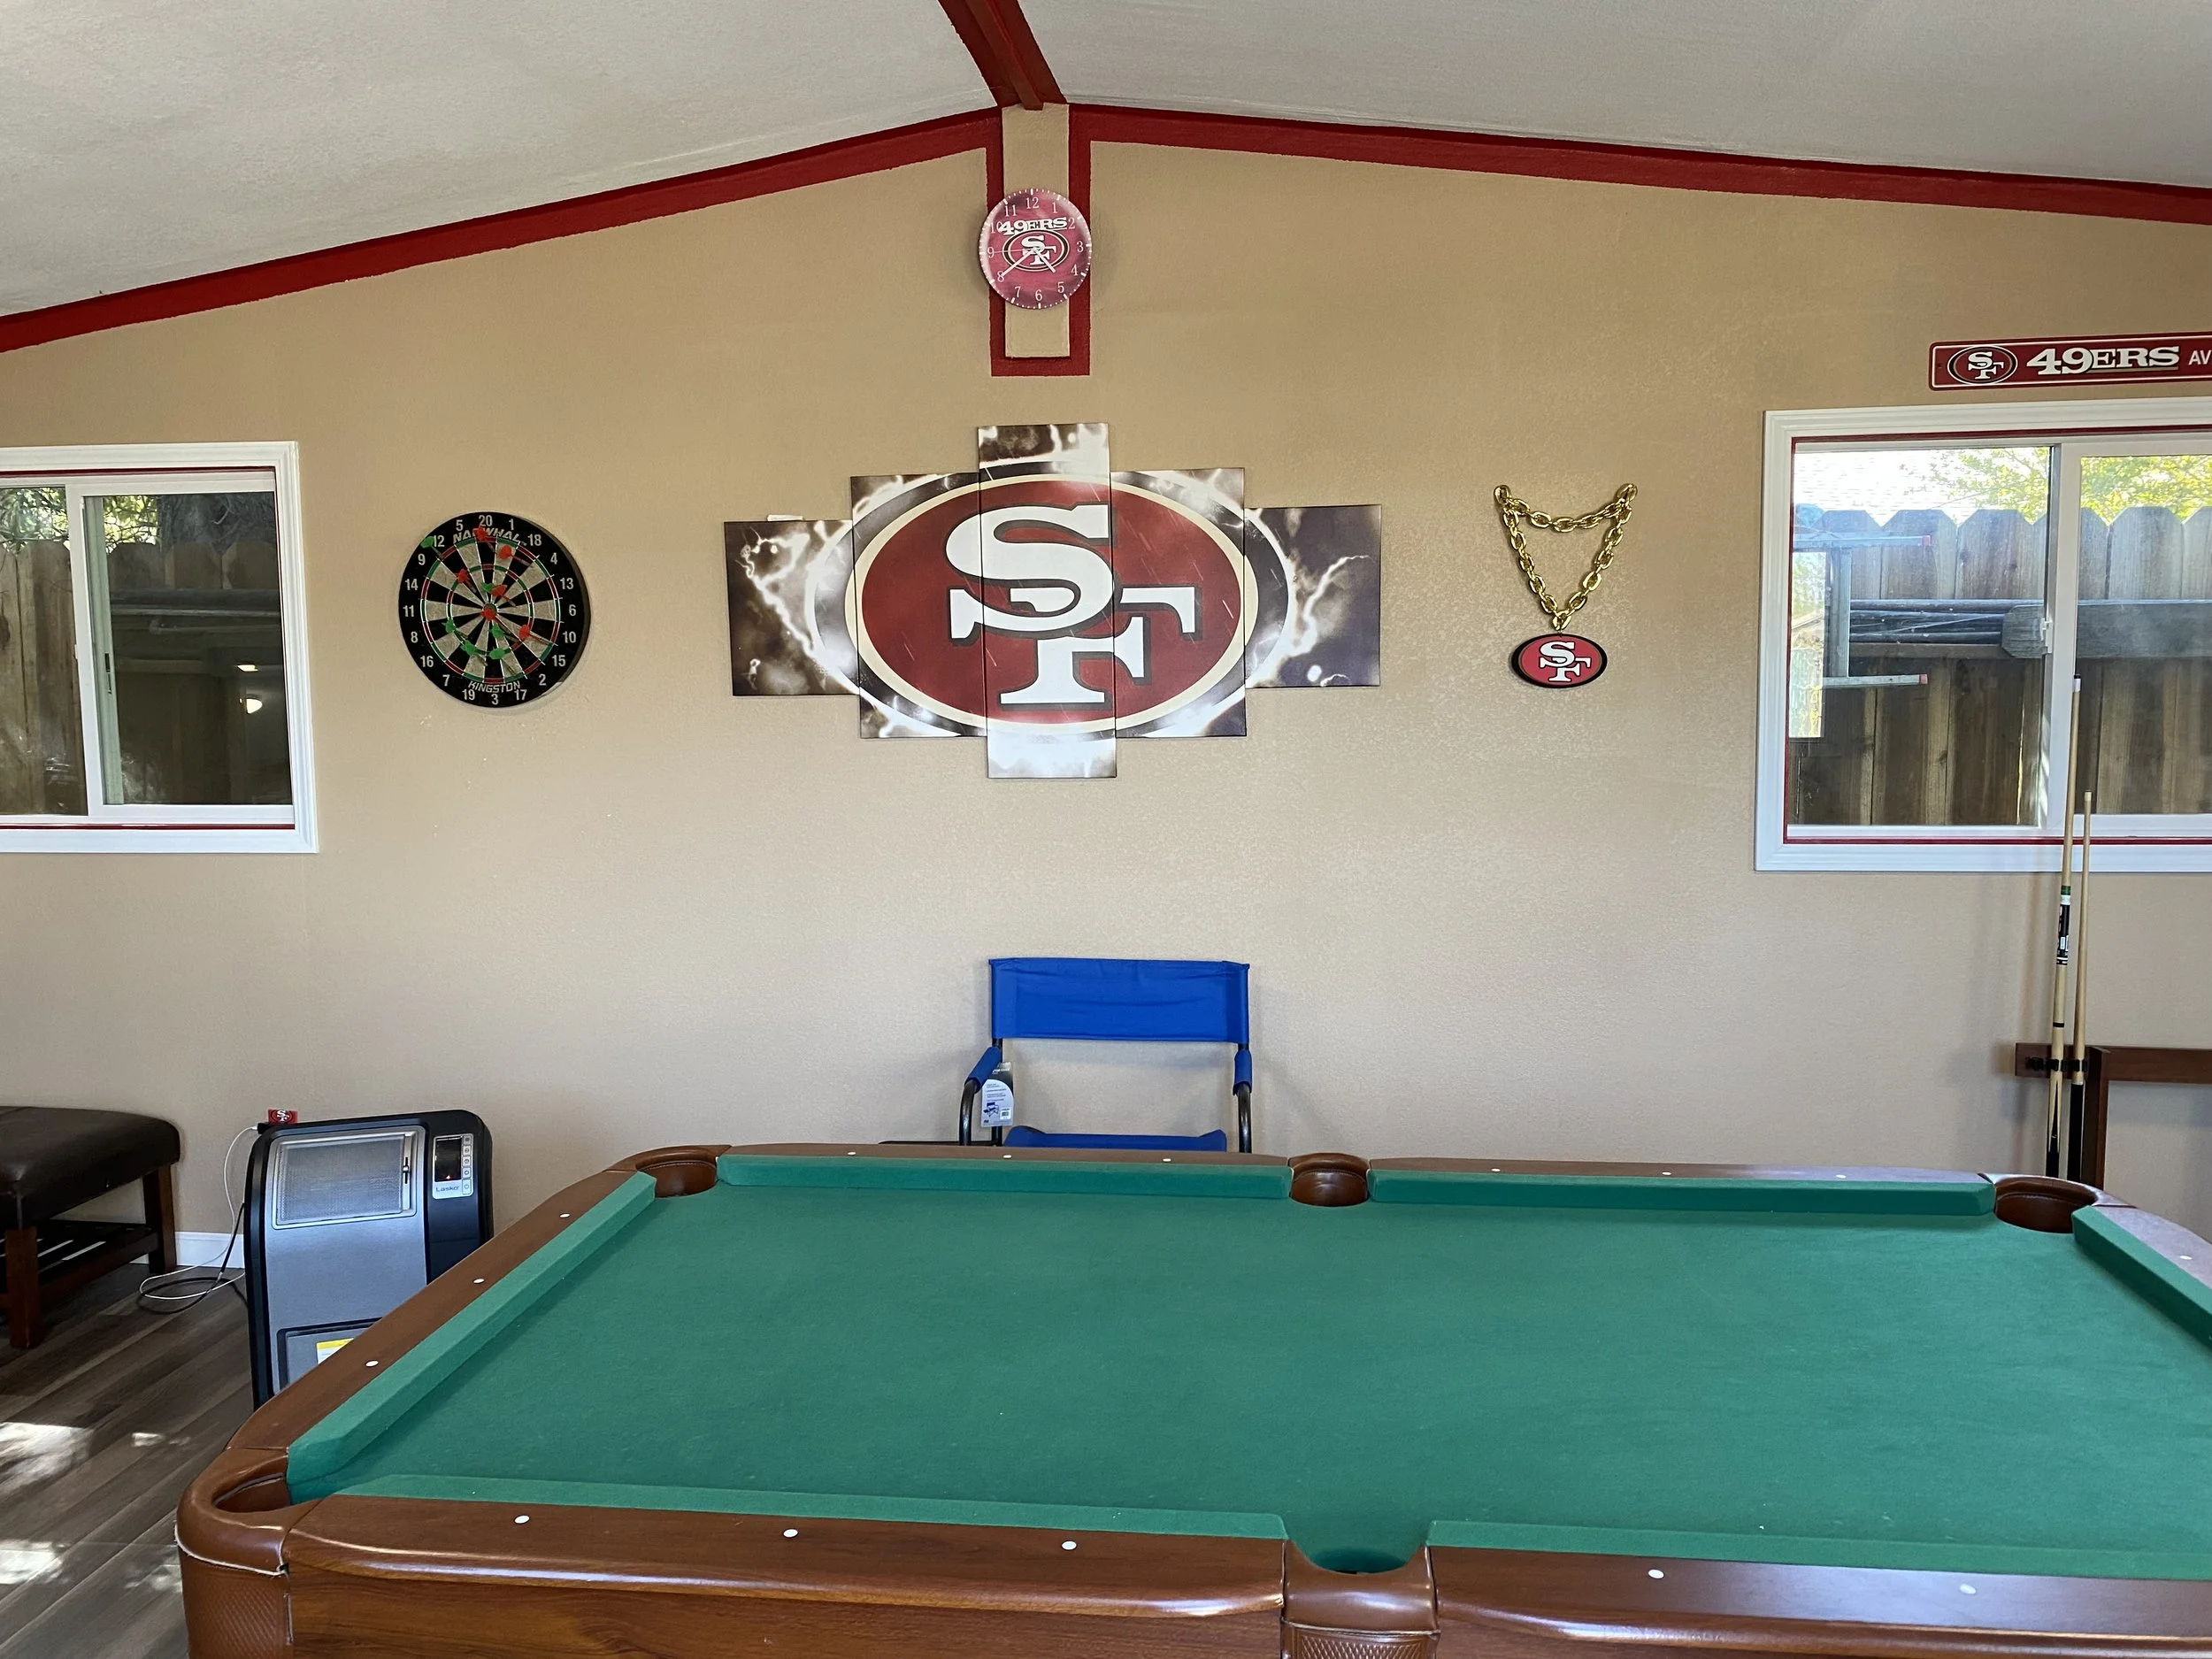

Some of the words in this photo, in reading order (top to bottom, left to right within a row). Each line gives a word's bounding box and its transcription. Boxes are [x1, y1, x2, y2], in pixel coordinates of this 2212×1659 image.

[1026, 197, 1040, 209] 12
[1052, 202, 1057, 213] 1
[1004, 205, 1017, 217] 11
[997, 217, 1068, 235] 49ERS
[1068, 218, 1076, 230] 2
[987, 247, 995, 258] 9
[1021, 235, 1056, 265] SF
[1077, 241, 1084, 253] 3
[1071, 264, 1079, 276] 4
[997, 271, 1004, 282] 8
[1015, 286, 1021, 298] 7
[1057, 281, 1064, 294] 5
[1035, 289, 1042, 301] 6
[1968, 351, 2004, 380] SF
[2026, 346, 2180, 375] 49ERS
[456, 519, 464, 532] 5
[479, 515, 493, 526] 20
[509, 518, 514, 530] 1
[433, 535, 445, 548] 12
[453, 527, 521, 544] NAWHAL
[527, 534, 541, 547] 18
[418, 554, 426, 565] 9
[550, 552, 558, 565] 4
[404, 579, 419, 591] 14
[560, 578, 574, 590] 13
[403, 605, 415, 617] 11
[569, 604, 577, 617] 6
[945, 503, 1199, 707] SF
[411, 631, 419, 643] 8
[563, 631, 577, 643] 10
[420, 656, 434, 668] 16
[552, 655, 565, 667] 15
[1540, 641, 1591, 682] SF
[442, 674, 450, 687] 7
[539, 674, 547, 686] 2
[467, 680, 521, 694] KINGSTON
[462, 688, 476, 701] 19
[491, 693, 499, 705] 3
[514, 688, 528, 701] 17
